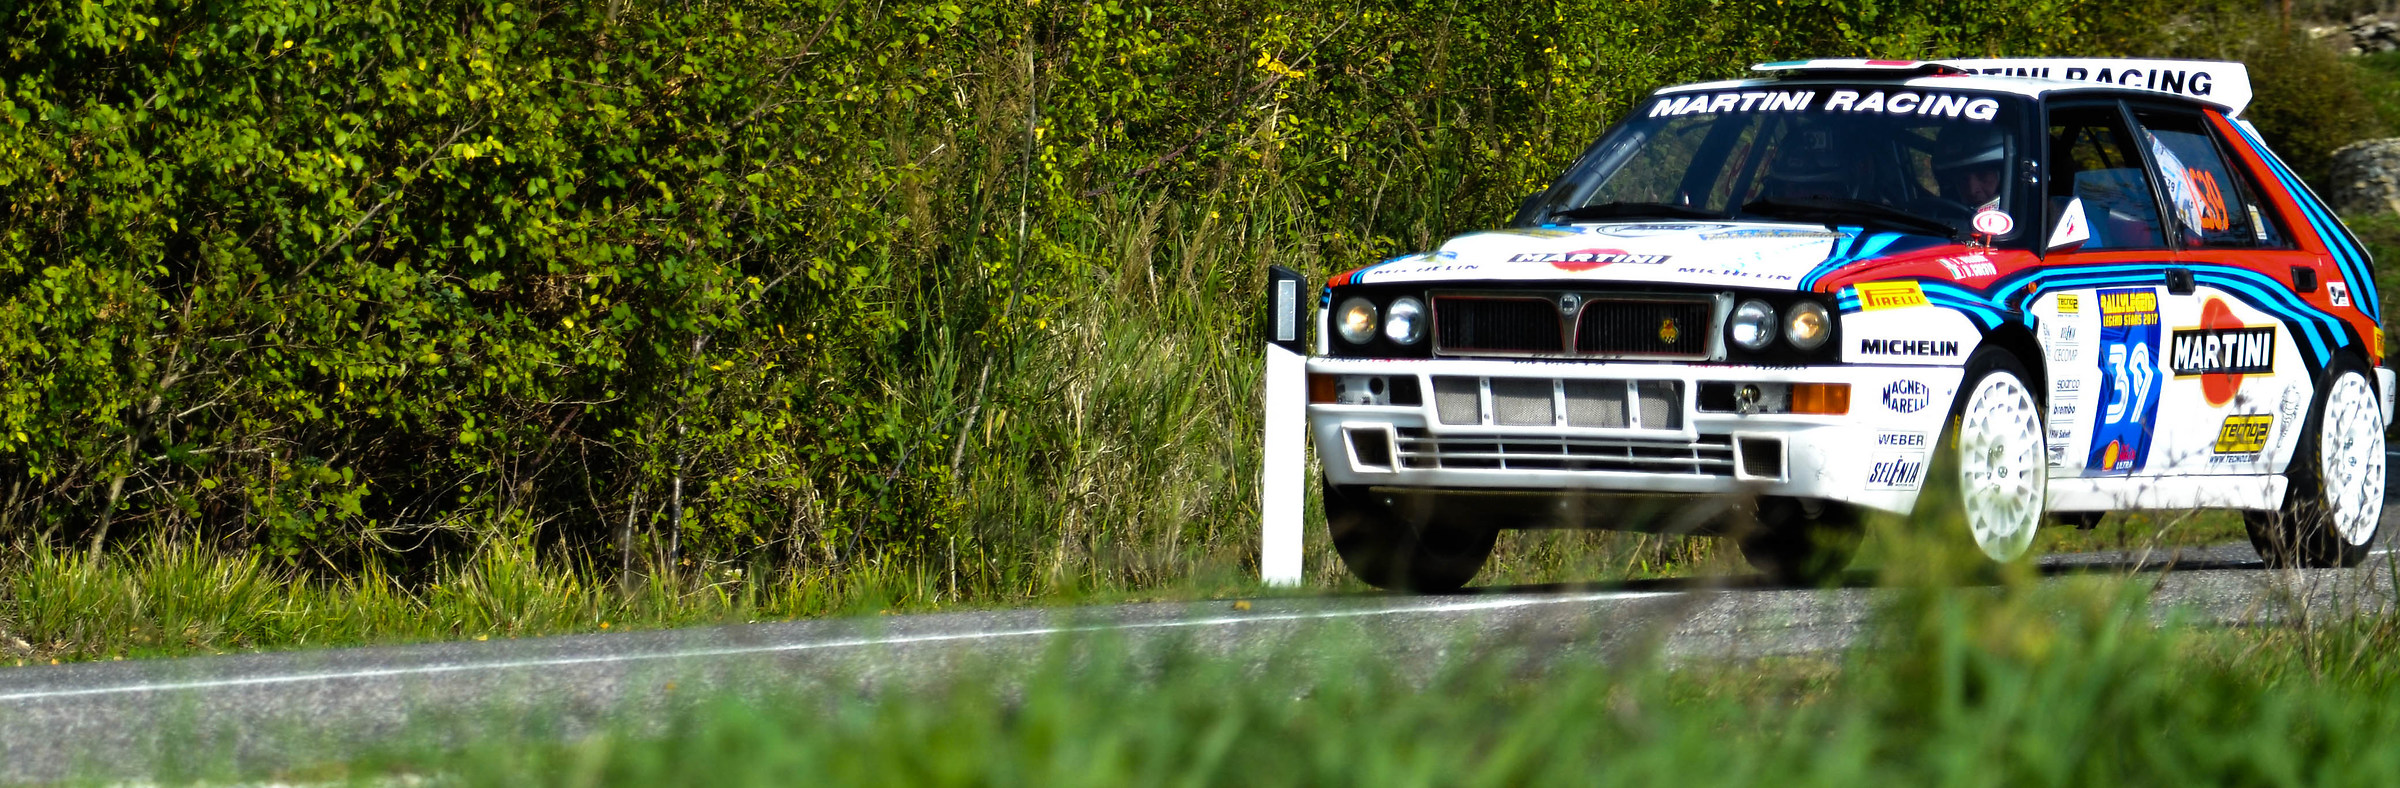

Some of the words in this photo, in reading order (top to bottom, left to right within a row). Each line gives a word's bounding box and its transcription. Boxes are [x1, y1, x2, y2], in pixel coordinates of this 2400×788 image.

[2065, 67, 2212, 96] RACING
[1649, 91, 1815, 118] MARTINI
[1824, 91, 2000, 121] RACING
[1511, 253, 1664, 264] MARTINI
[1864, 287, 1921, 307] PIRELLI
[2143, 312, 2159, 325] 2017
[1861, 338, 1958, 356] MICHELIN
[2173, 332, 2271, 370] MARTINI
[1883, 379, 1929, 402] MAGNETI
[2105, 342, 2154, 424] 39
[1883, 394, 1929, 413] MARELLI
[2053, 403, 2076, 415] brembo
[1879, 434, 1925, 446] WEBER
